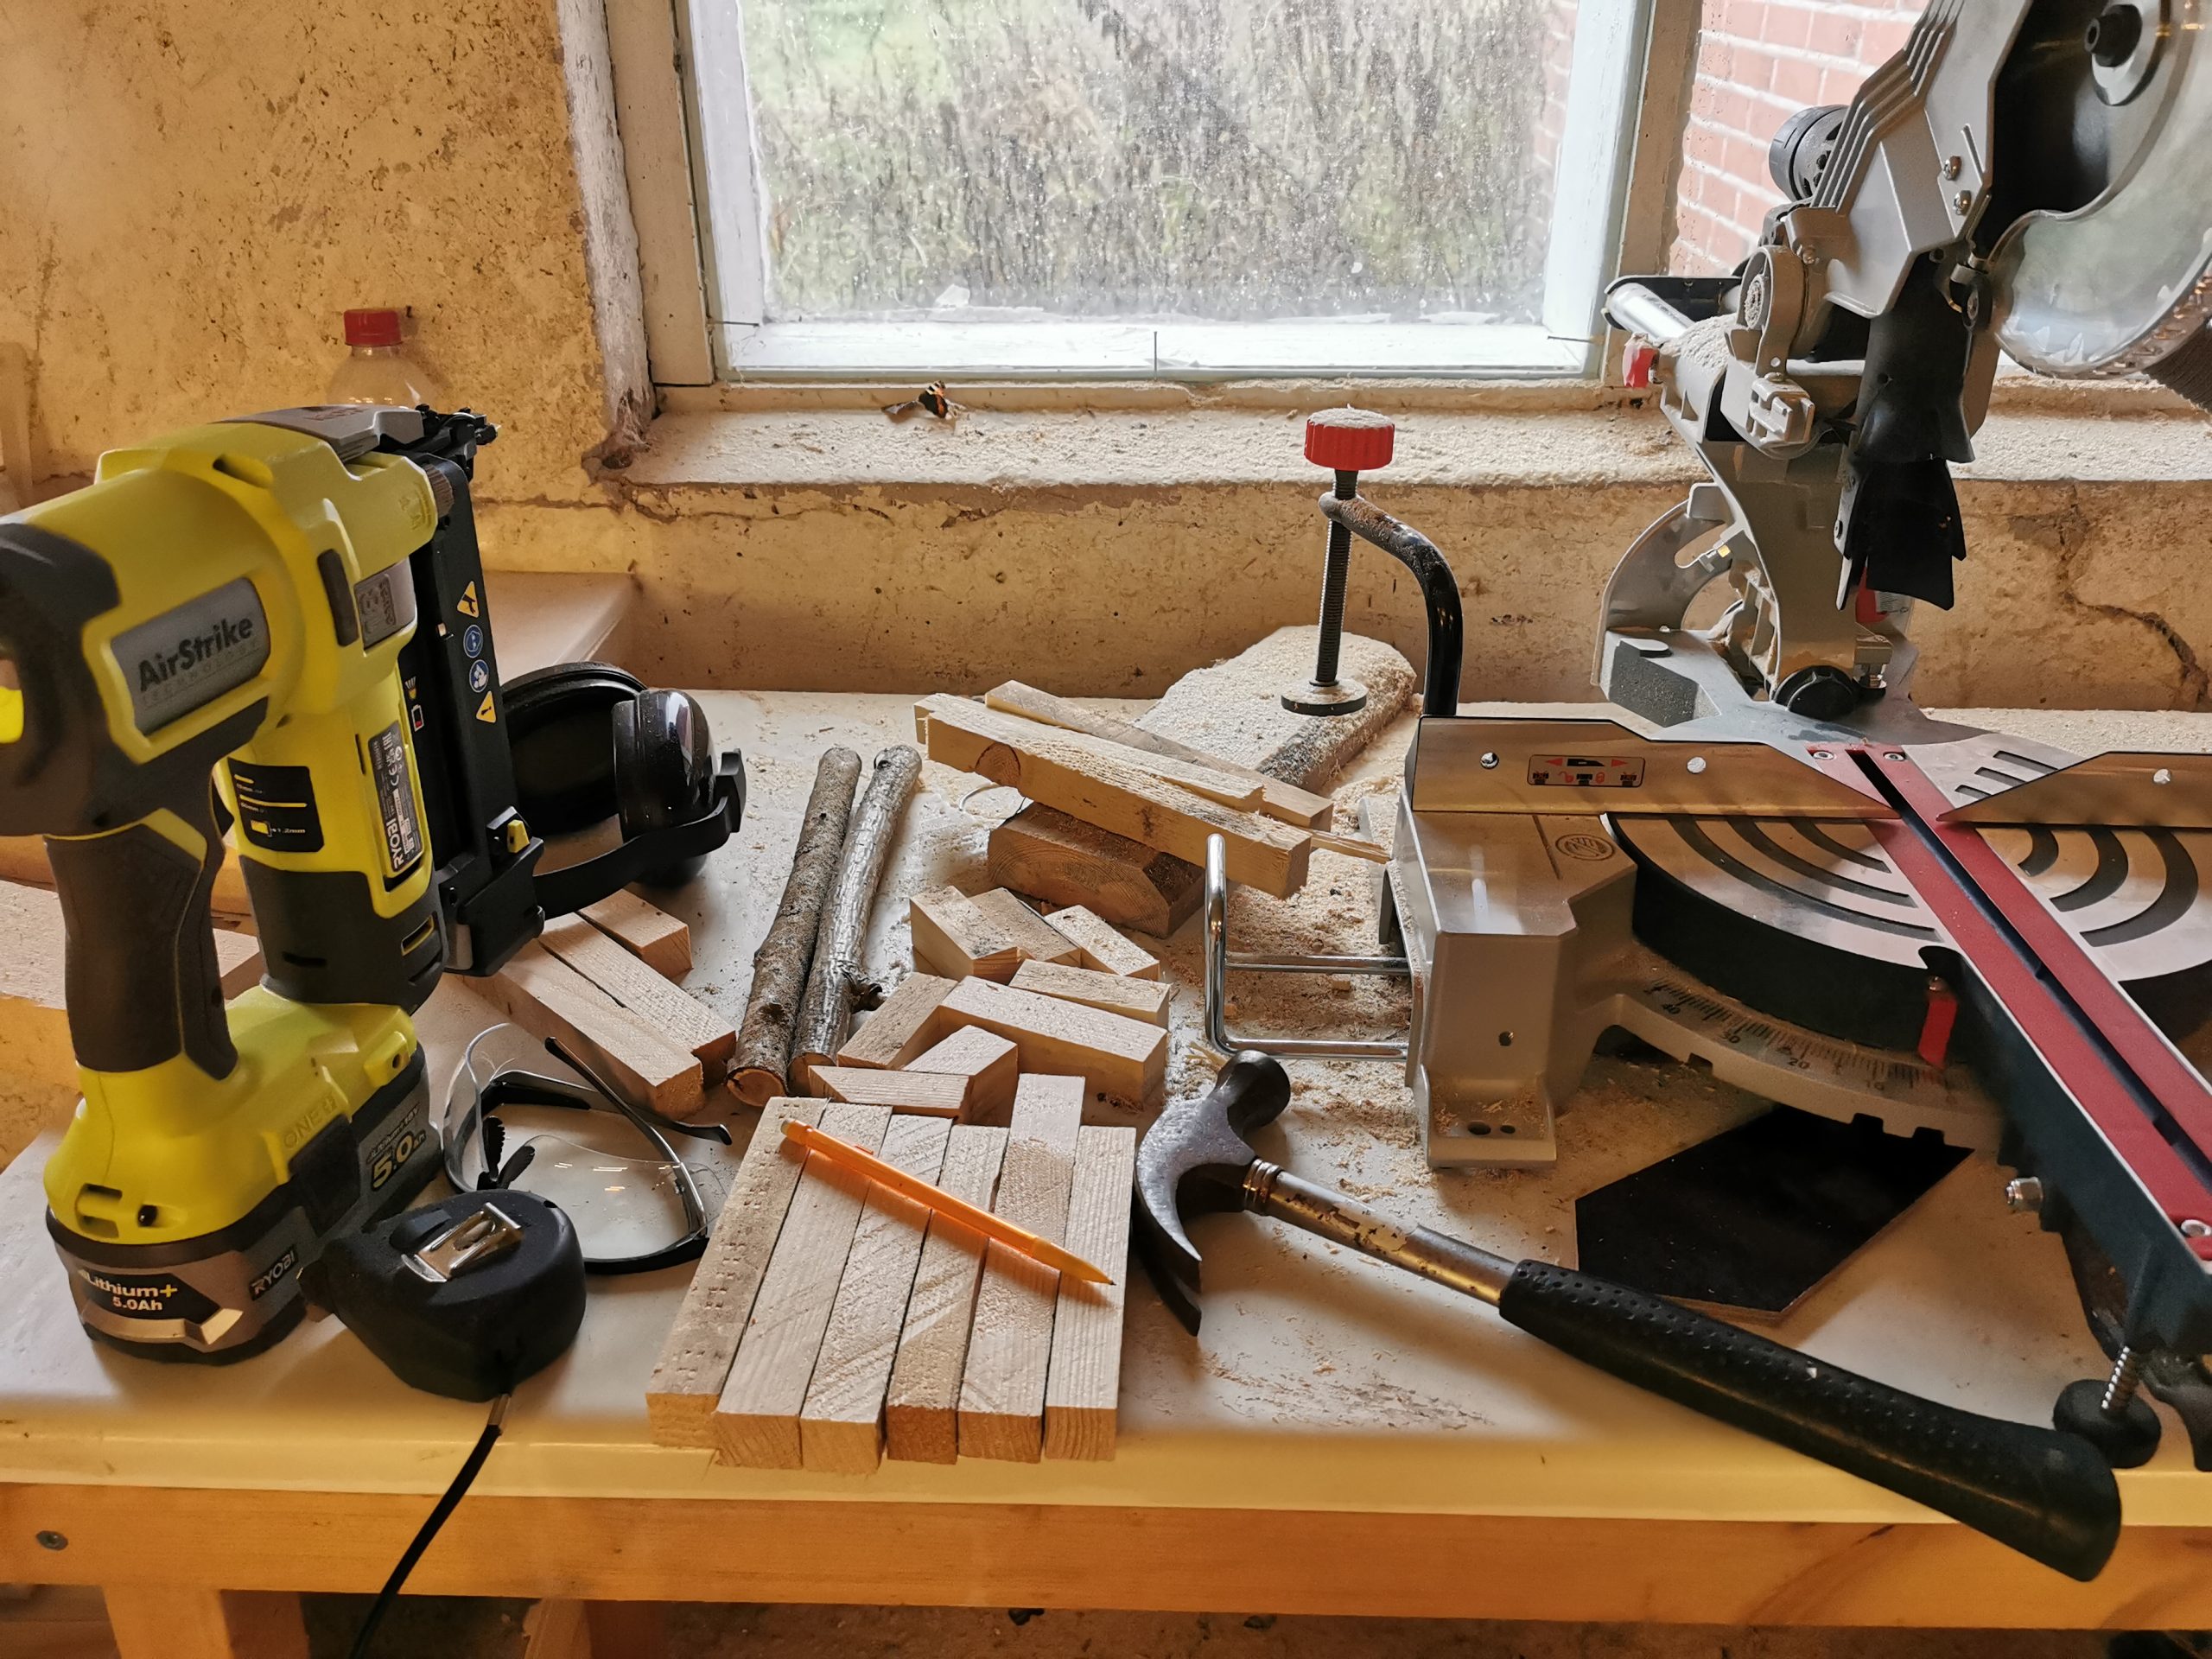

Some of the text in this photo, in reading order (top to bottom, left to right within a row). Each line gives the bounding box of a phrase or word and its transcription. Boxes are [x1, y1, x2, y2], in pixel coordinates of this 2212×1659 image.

[138, 618, 253, 692] AirStrike
[385, 817, 404, 869] RYOBI
[1789, 1058, 1810, 1070] 20
[85, 1273, 178, 1297] Lithium+
[251, 1249, 296, 1294] RYOBI
[112, 1296, 162, 1311] 5.0Ah
